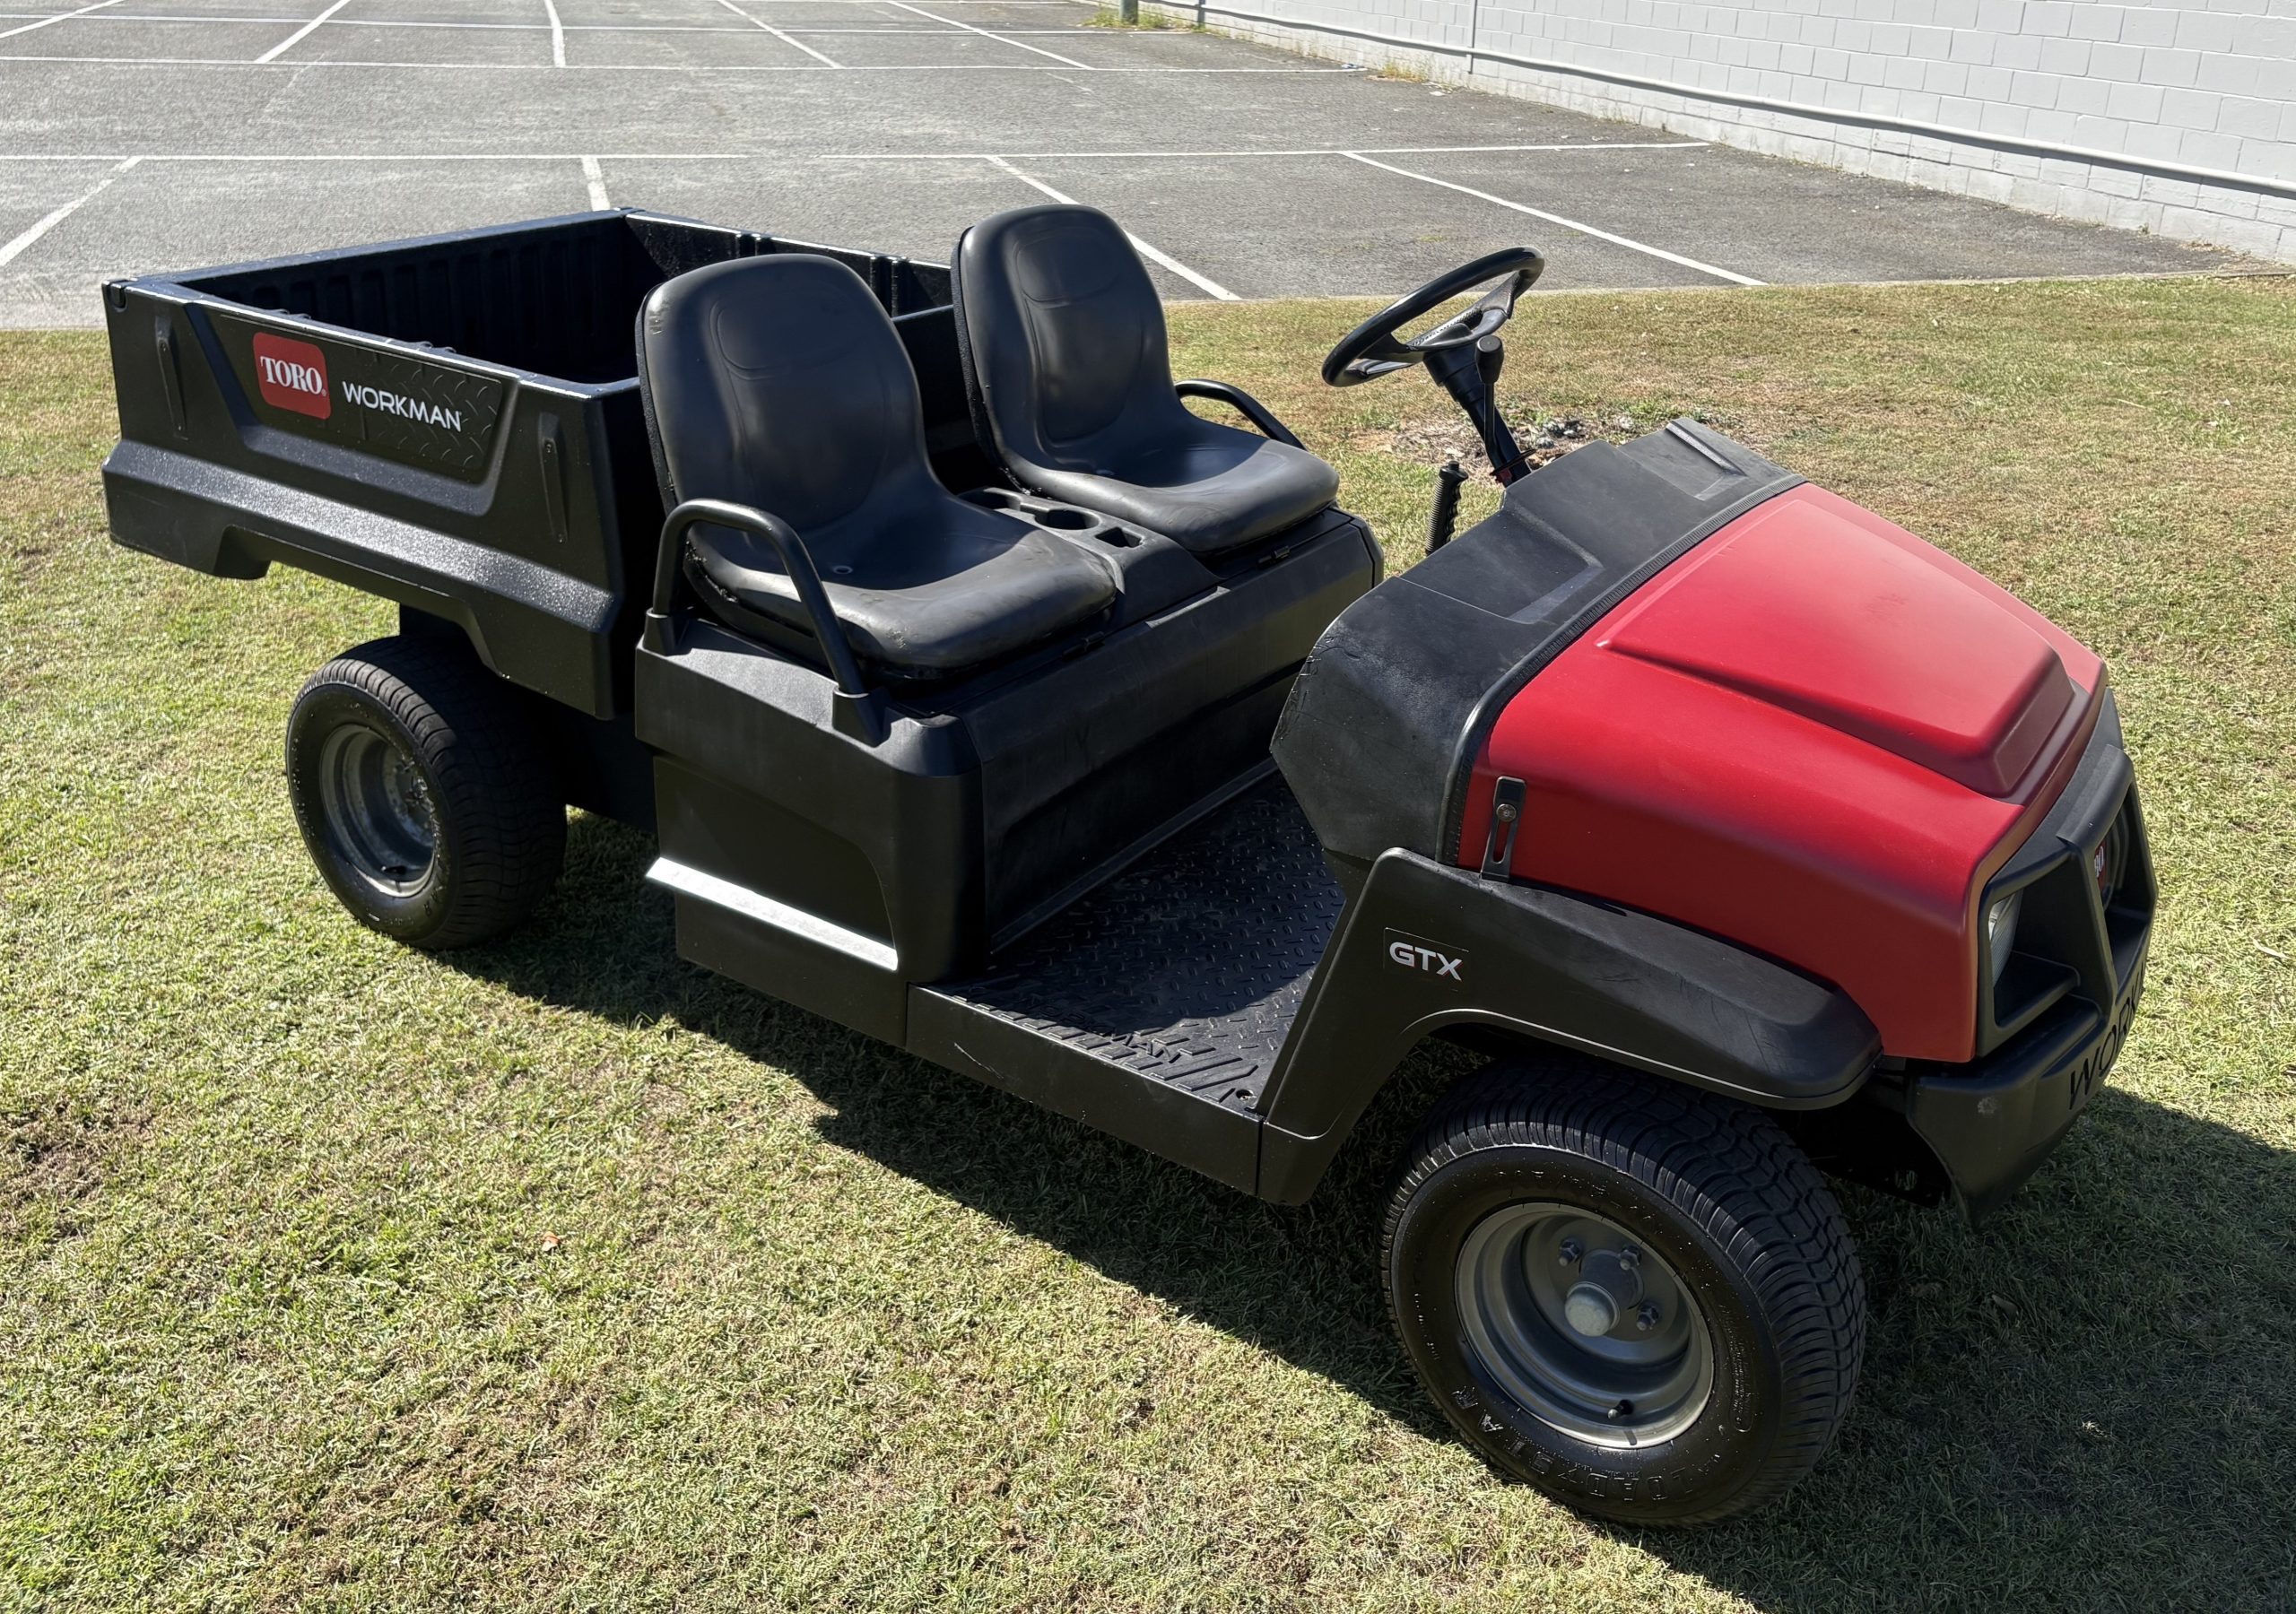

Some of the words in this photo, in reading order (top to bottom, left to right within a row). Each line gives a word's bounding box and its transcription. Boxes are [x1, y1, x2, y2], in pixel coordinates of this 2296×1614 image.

[260, 355, 324, 395] TORO
[342, 380, 462, 432] WORKMAN
[1389, 941, 1463, 982] GTX
[2068, 959, 2145, 1111] WORK
